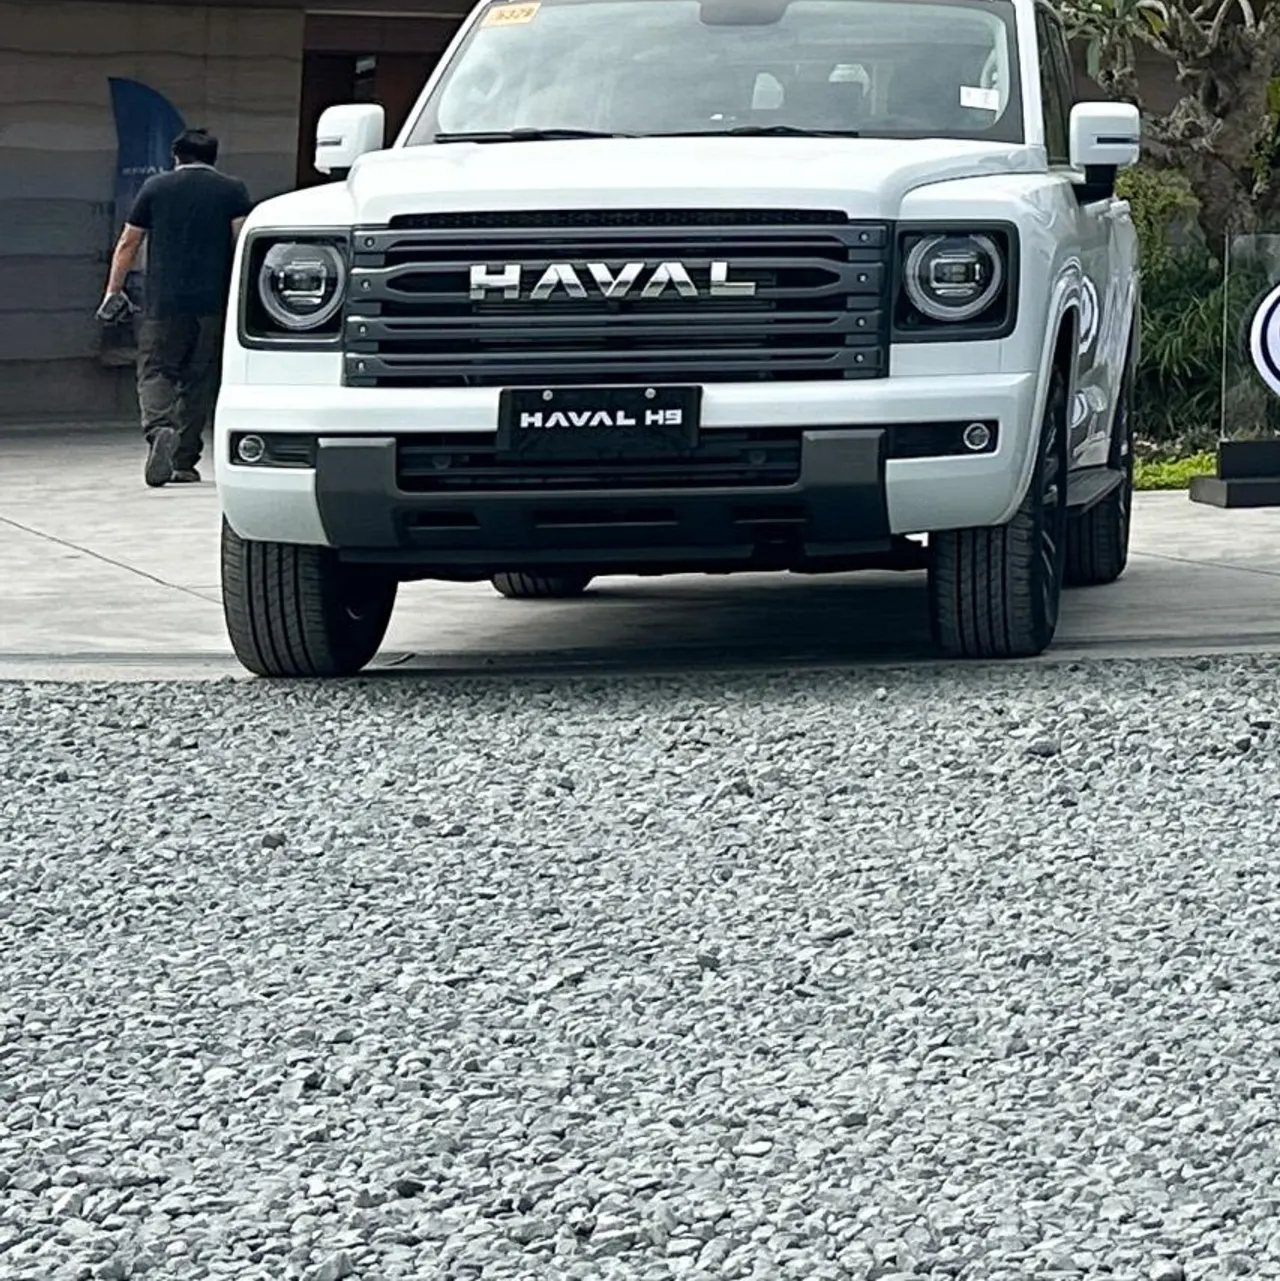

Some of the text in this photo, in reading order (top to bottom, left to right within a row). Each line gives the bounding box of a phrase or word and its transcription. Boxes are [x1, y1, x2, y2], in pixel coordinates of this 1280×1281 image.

[470, 261, 756, 299] HAVAL
[520, 409, 682, 428] HAVAL H9
